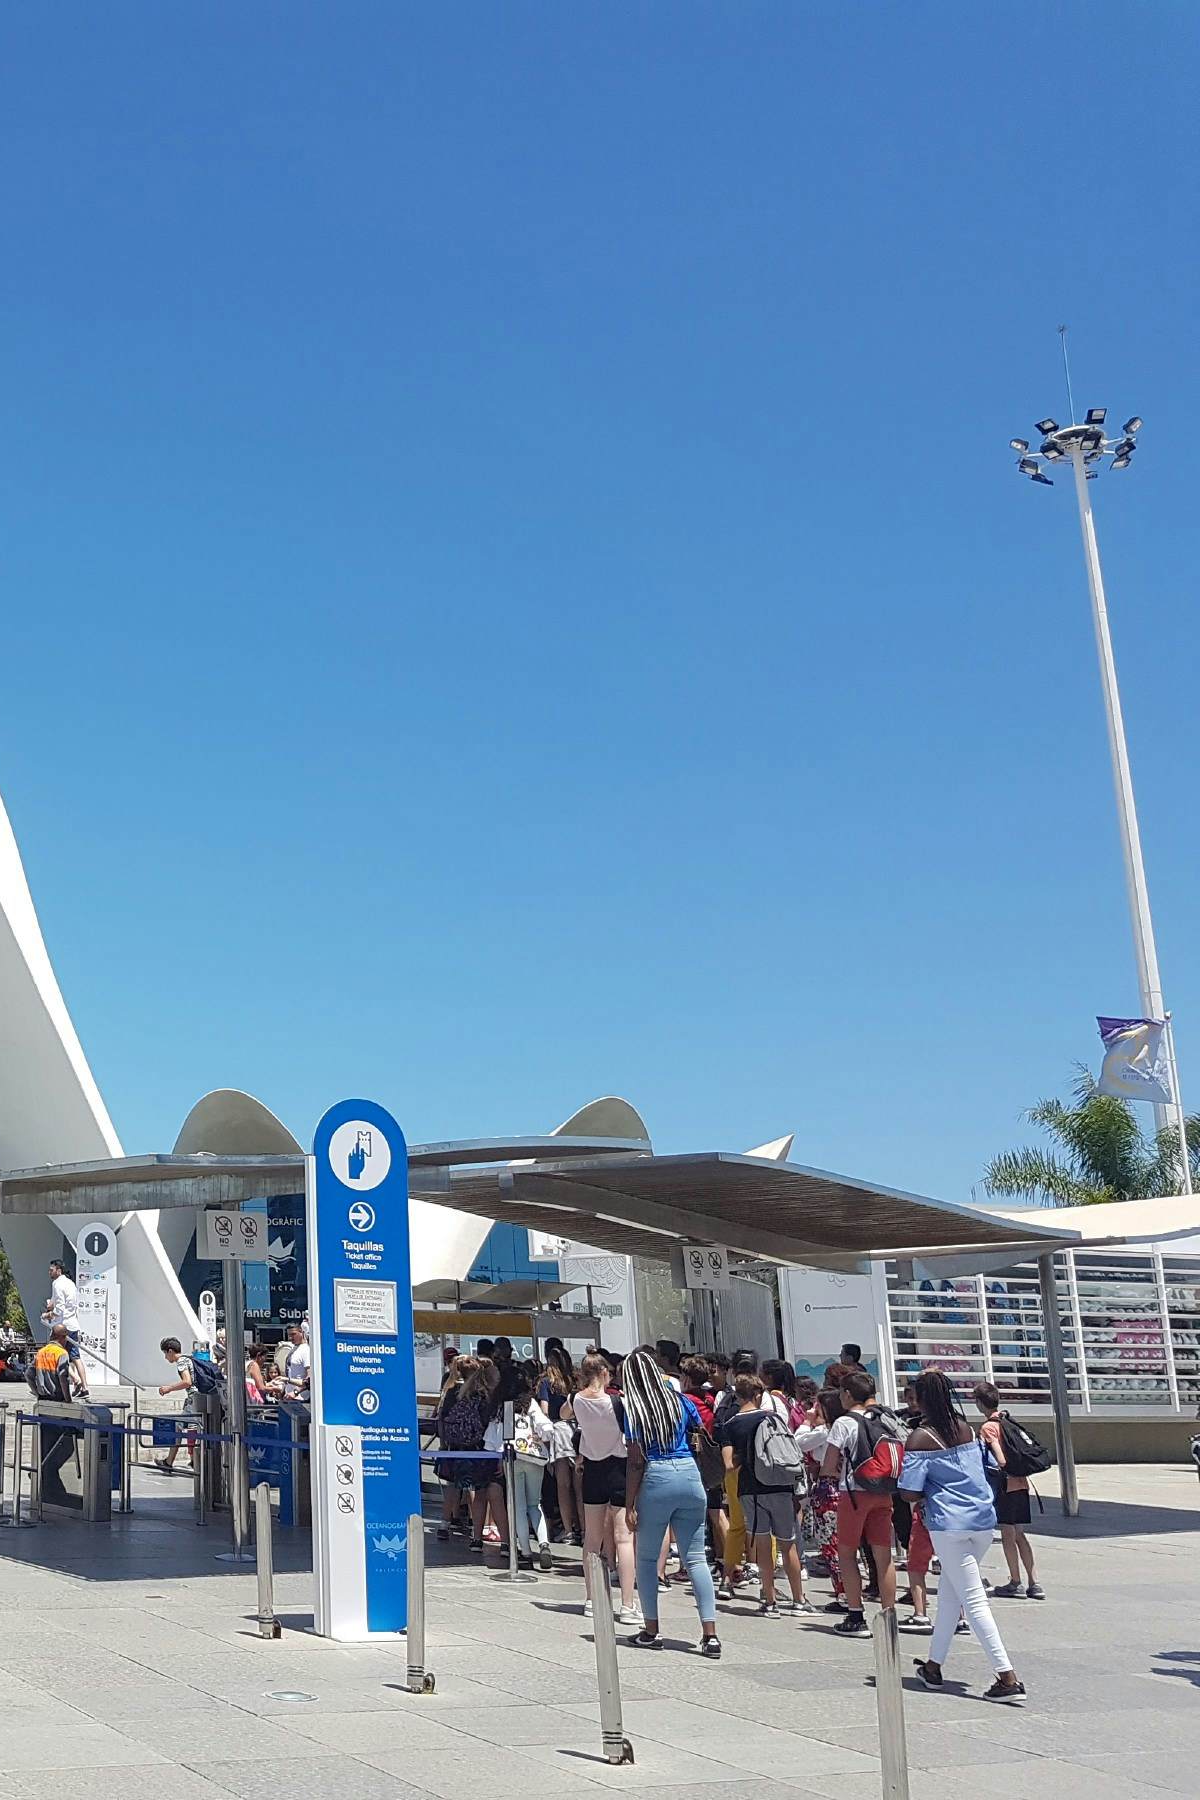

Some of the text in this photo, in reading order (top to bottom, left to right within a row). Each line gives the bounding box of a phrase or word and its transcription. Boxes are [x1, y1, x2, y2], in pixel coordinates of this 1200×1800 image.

[341, 1240, 384, 1252] Taquillas
[344, 1252, 364, 1260] Ticket
[573, 1303, 623, 1319] Phoo-Aqua
[337, 1342, 396, 1354] Bienvenidos
[350, 1365, 384, 1374] Benvinguts
